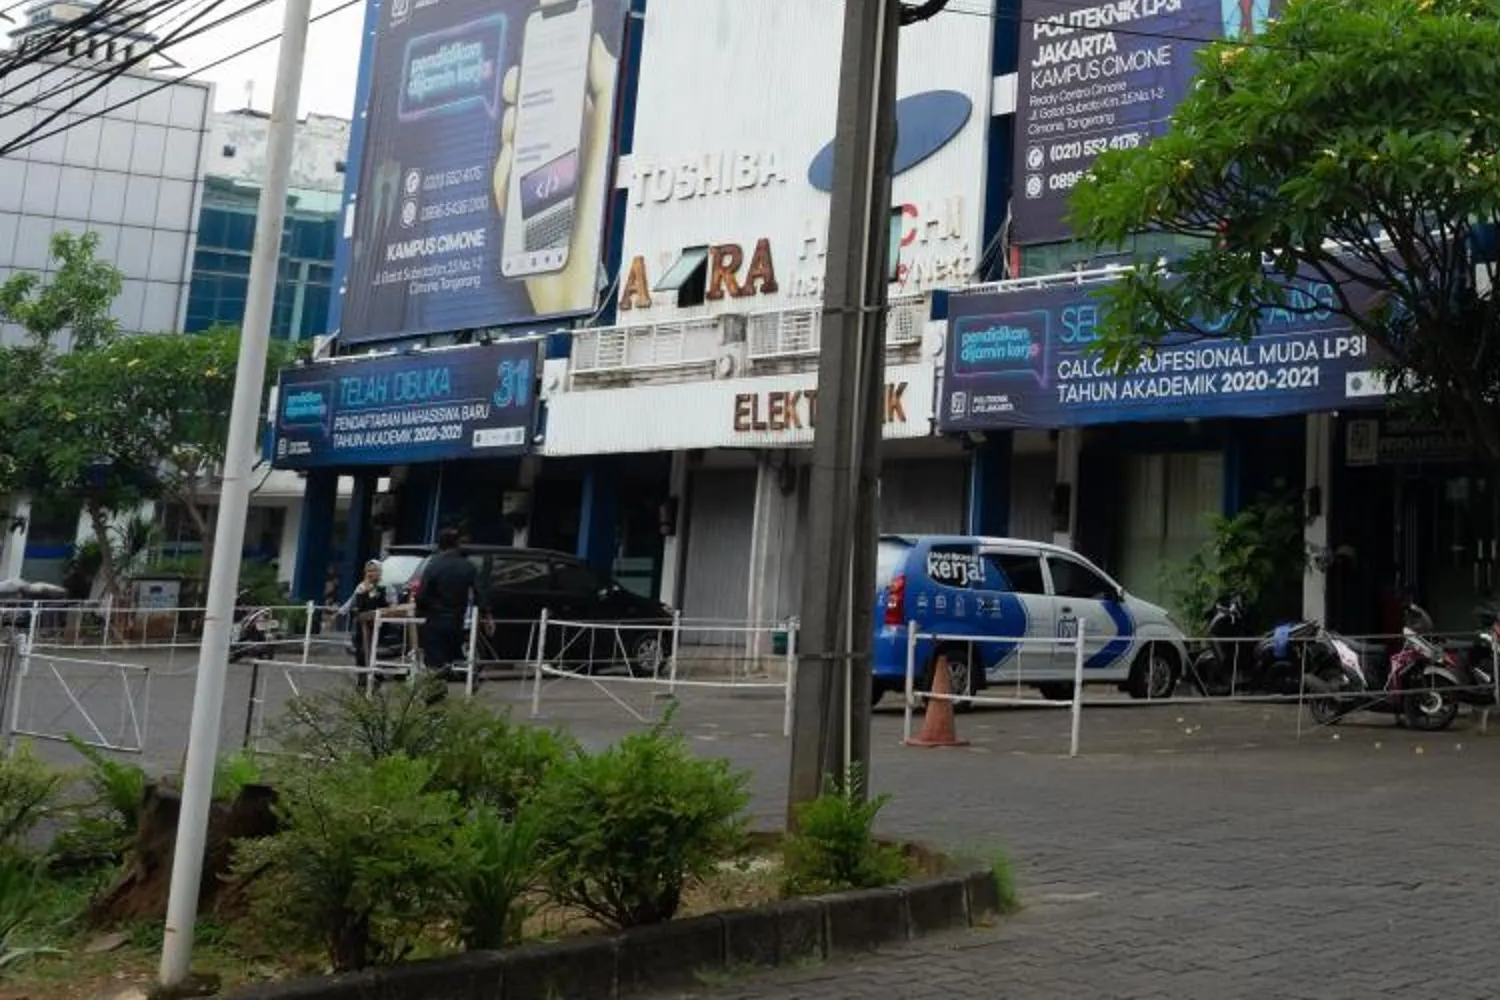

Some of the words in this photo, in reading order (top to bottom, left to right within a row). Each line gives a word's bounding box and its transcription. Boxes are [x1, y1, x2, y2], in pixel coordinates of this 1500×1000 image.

[1030, 59, 1100, 91] KAMPUS
[1101, 44, 1172, 78] CIMONE
[1031, 31, 1118, 68] JAKARTA
[634, 149, 788, 209] TOSHIBA
[1259, 340, 1320, 365] MUDA
[1323, 335, 1367, 359] LP3I
[339, 374, 388, 406] TELAH
[1056, 381, 1117, 403] TAHUN
[1120, 373, 1218, 400] AKADEMIK
[1221, 365, 1320, 393] 2020-2021
[927, 555, 986, 585] kerja!
